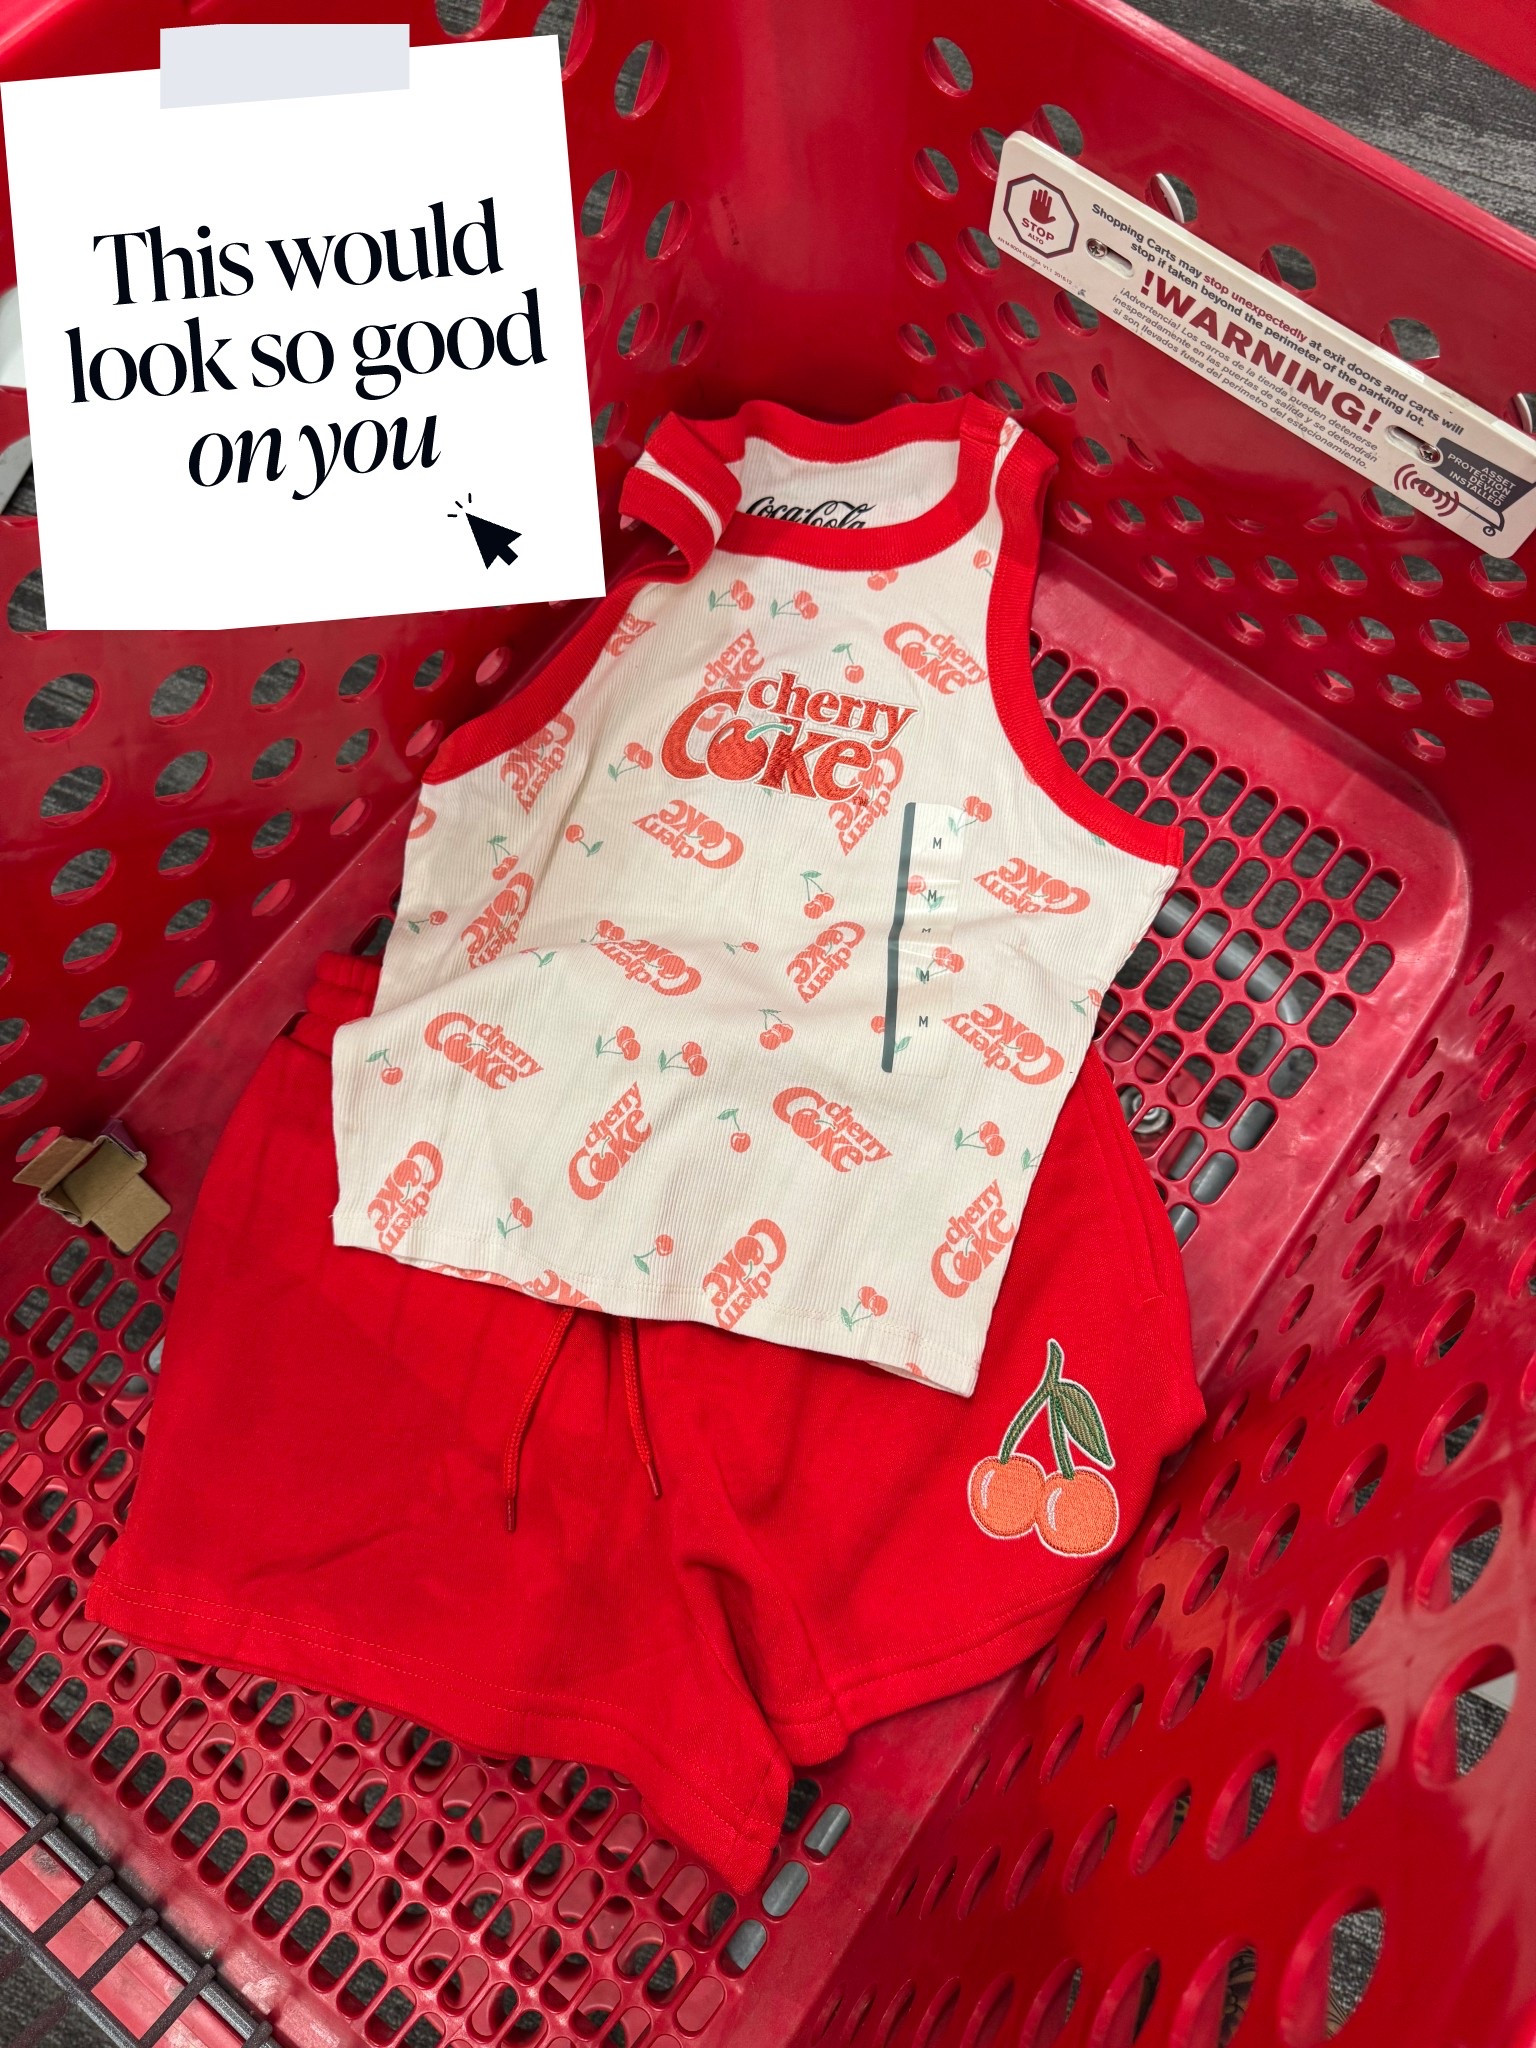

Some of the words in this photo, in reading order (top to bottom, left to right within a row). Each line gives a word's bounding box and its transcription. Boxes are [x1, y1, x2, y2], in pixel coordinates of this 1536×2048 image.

[1021, 217, 1054, 240] STOP
[1027, 232, 1043, 244] ALTO
[1092, 203, 1144, 243] Shopping
[1146, 238, 1176, 261] Carts
[1178, 259, 1202, 278] may
[1203, 275, 1228, 294] stop
[1231, 292, 1307, 342] unexpectedly
[1308, 340, 1322, 351] at
[1323, 348, 1345, 365] exit
[1347, 363, 1381, 386] doors
[1383, 385, 1408, 401] and
[1409, 400, 1439, 421] carts
[1441, 418, 1464, 435] will
[1130, 243, 1155, 262] stop
[1157, 257, 1166, 268] if
[1167, 264, 1198, 289] taken
[1200, 285, 1242, 316] beyond
[1244, 312, 1262, 329] the
[1264, 327, 1321, 363] perimeter
[1322, 362, 1337, 372] of
[1337, 369, 1356, 385] the
[1357, 383, 1403, 414] parking
[1405, 410, 1424, 426] lot.
[1112, 294, 1190, 348] inesperadamente
[1192, 347, 1204, 357] en
[1205, 354, 1221, 367] las
[1221, 366, 1258, 390] puertas
[1260, 389, 1273, 399] de
[1274, 398, 1304, 418] salida
[1312, 422, 1325, 432] se
[1327, 430, 1377, 462] detendrán
[1142, 271, 1379, 431] !WARNING!
[1181, 327, 1198, 341] Los
[1199, 340, 1230, 361] carros
[1231, 360, 1244, 370] de
[1245, 367, 1255, 377] la
[1257, 375, 1287, 396] tienda
[1288, 395, 1326, 420] pueden
[1122, 314, 1139, 332] son
[1140, 324, 1178, 352] llevados
[1180, 349, 1204, 368] fuera
[1206, 367, 1222, 379] del
[1269, 407, 1286, 418] del
[1287, 417, 1366, 468] estacionamiento.
[1447, 453, 1510, 495] PROTECTION
[1449, 471, 1501, 506] INSTALLED
[1469, 475, 1505, 501] DEVICE
[1479, 467, 1515, 489] ASSET
[704, 628, 756, 687] cherry
[883, 622, 967, 694] Coke
[930, 633, 986, 685] cherry
[747, 669, 919, 751] cherry
[661, 688, 874, 801] Coke
[632, 813, 694, 859] cherry
[659, 800, 744, 869] Coke
[838, 791, 892, 856] cherry
[932, 837, 942, 850] M
[460, 873, 535, 956] Coke
[928, 889, 938, 901] M
[974, 870, 1041, 914] cherry
[998, 858, 1091, 915] Coke
[786, 921, 865, 984] Coke
[798, 947, 852, 1004] cherry
[920, 970, 930, 982] M
[424, 1012, 518, 1090] Coke
[476, 1023, 544, 1078] cherry
[918, 1016, 928, 1027] M
[942, 1013, 1011, 1070] cherry
[971, 1003, 1065, 1085] Coke
[585, 1081, 641, 1148] cherry
[773, 1087, 864, 1173] Coke
[825, 1102, 893, 1162] cherry
[569, 1109, 652, 1200] Coke
[367, 1141, 443, 1232] Coke
[946, 1179, 1003, 1244] cherry
[378, 1191, 430, 1254] cherry
[931, 1208, 1016, 1299] Coke
[703, 1219, 787, 1307] Coke
[715, 1271, 771, 1330] cherry
